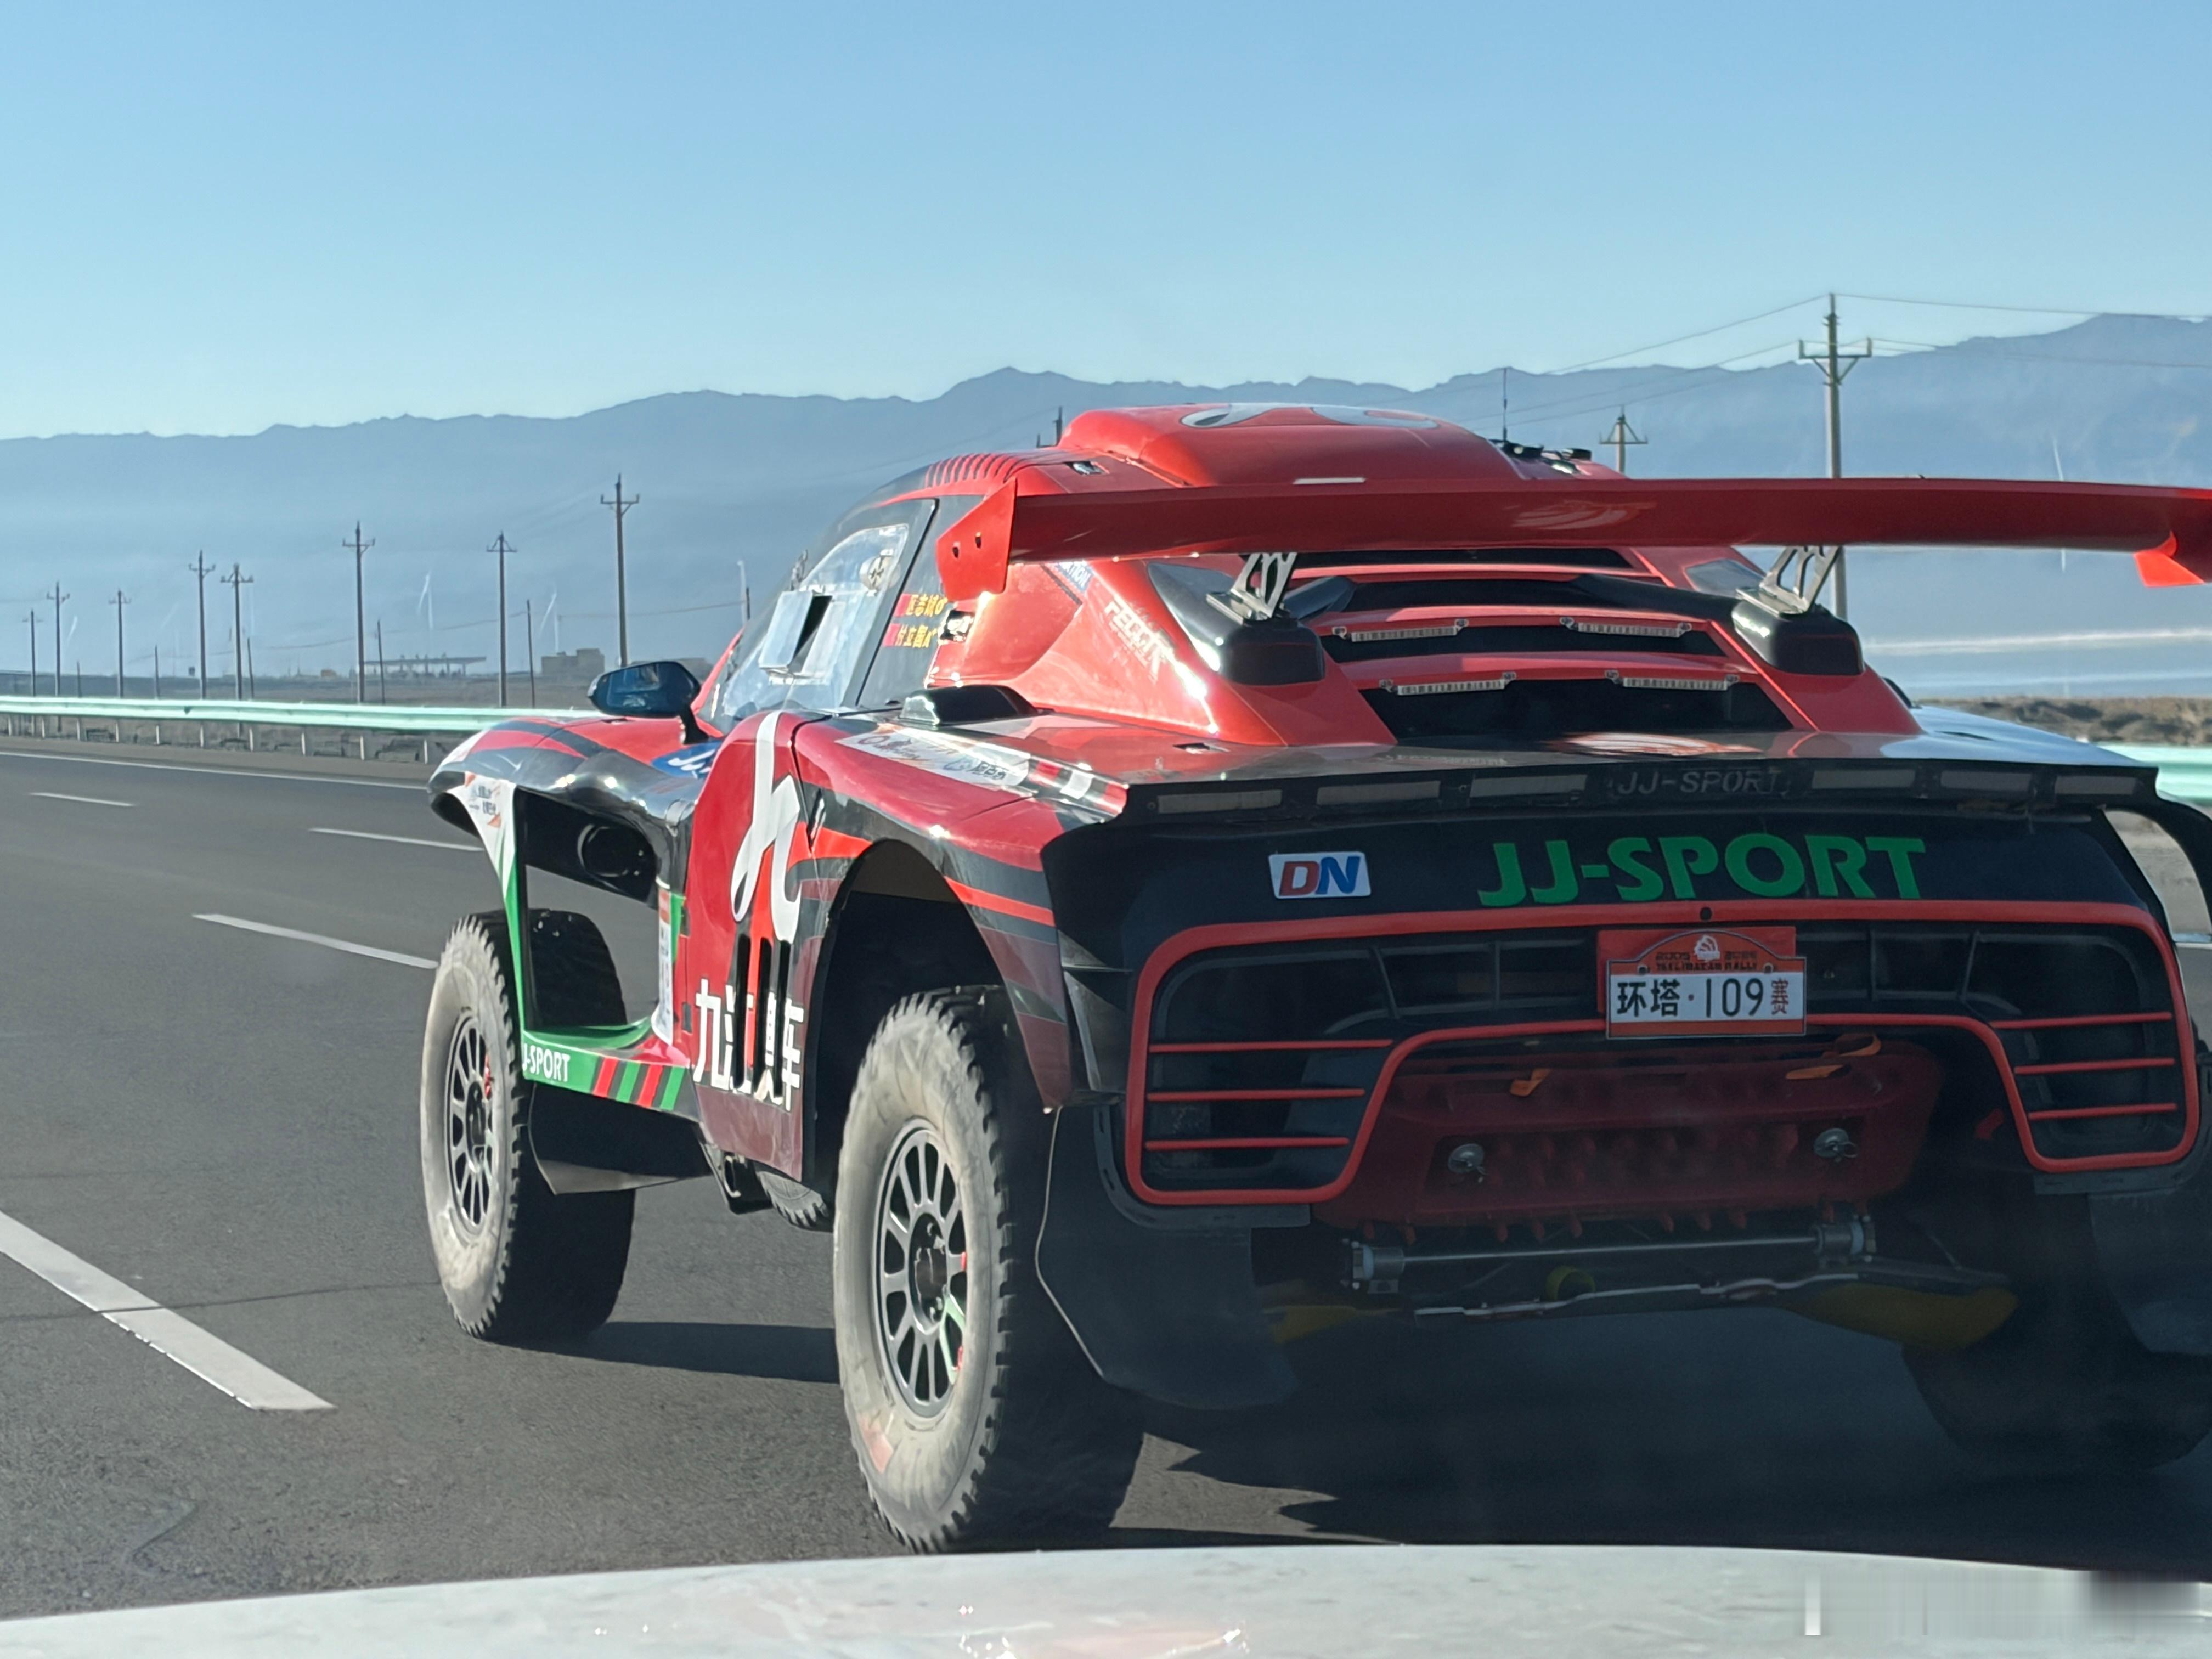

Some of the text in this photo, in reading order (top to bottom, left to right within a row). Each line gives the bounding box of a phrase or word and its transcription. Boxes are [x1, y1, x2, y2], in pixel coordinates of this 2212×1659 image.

[1617, 766, 1783, 795] JJ-SPORT
[1279, 855, 1360, 898] DN
[1478, 833, 1927, 906] JJ-SPORT
